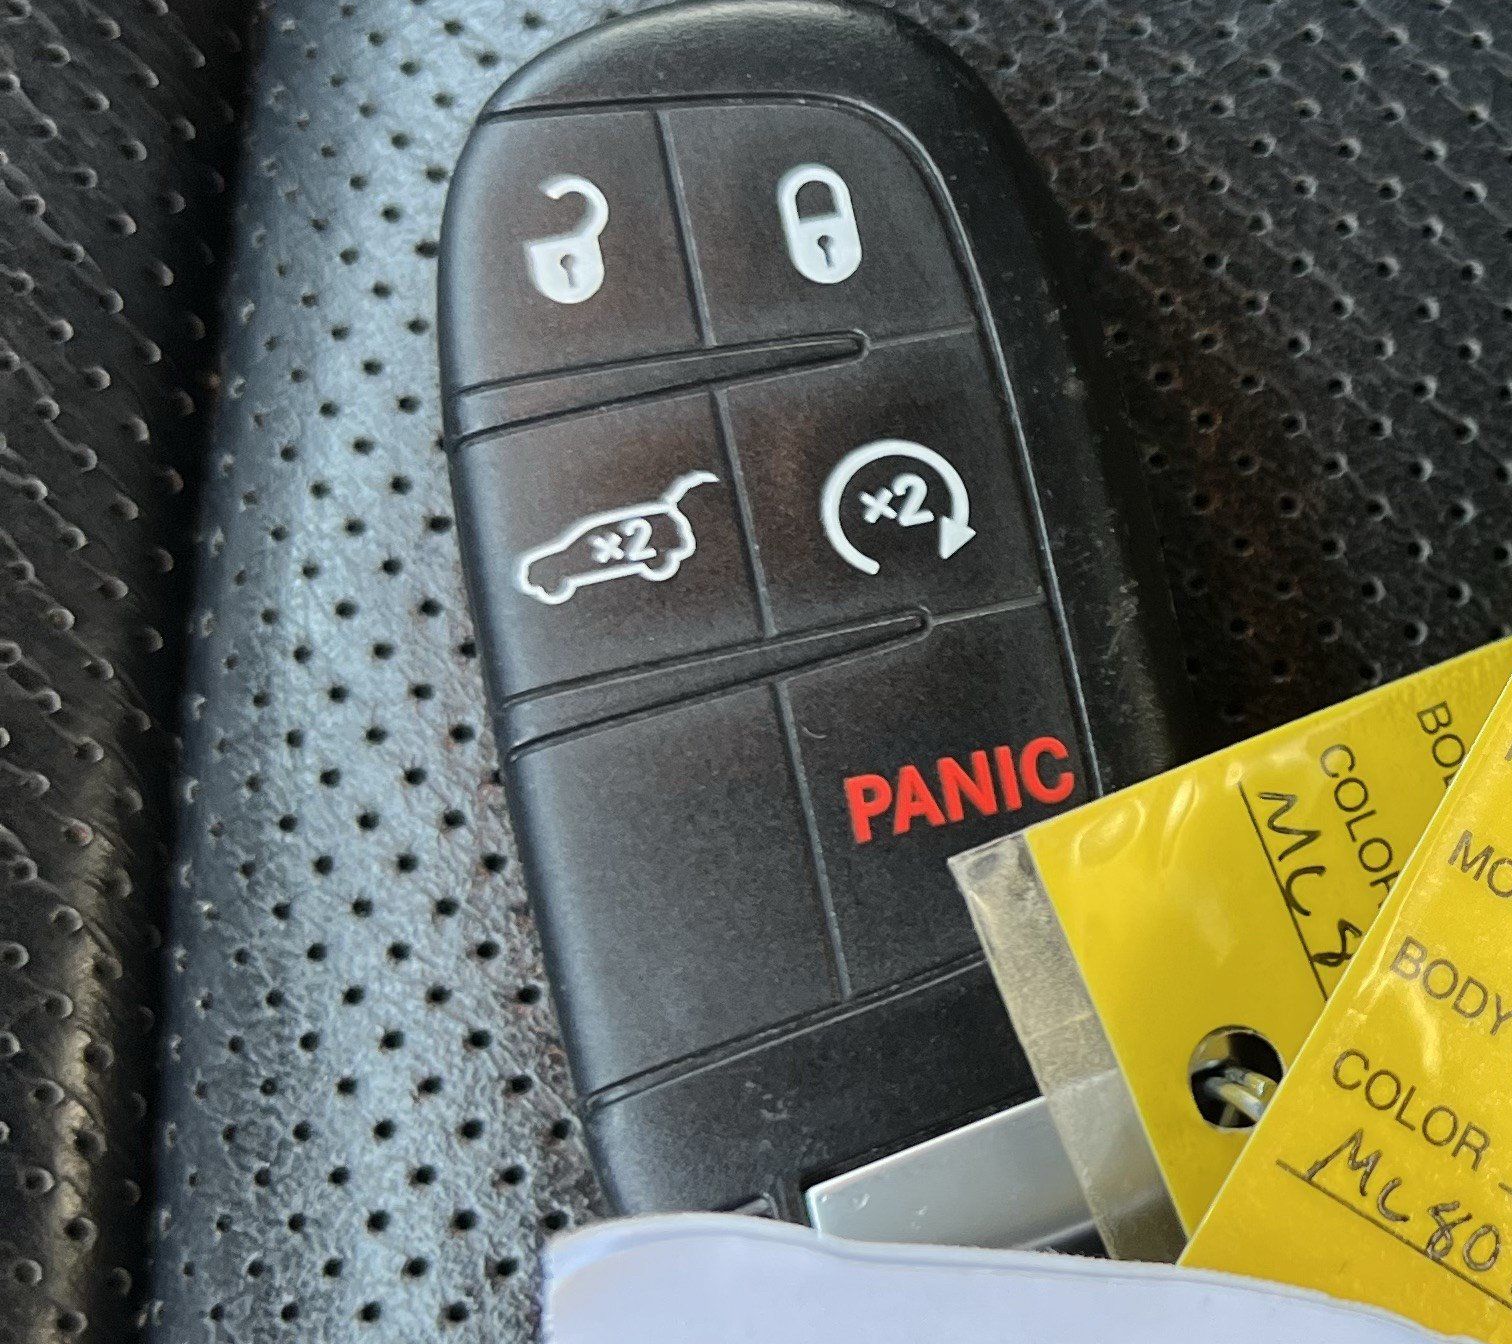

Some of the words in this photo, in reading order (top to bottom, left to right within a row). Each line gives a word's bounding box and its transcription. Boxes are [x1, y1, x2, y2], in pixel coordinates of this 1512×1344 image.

[843, 735, 1077, 845] PANIC
[1416, 700, 1466, 790] BO
[1332, 1048, 1491, 1173] COLOR
